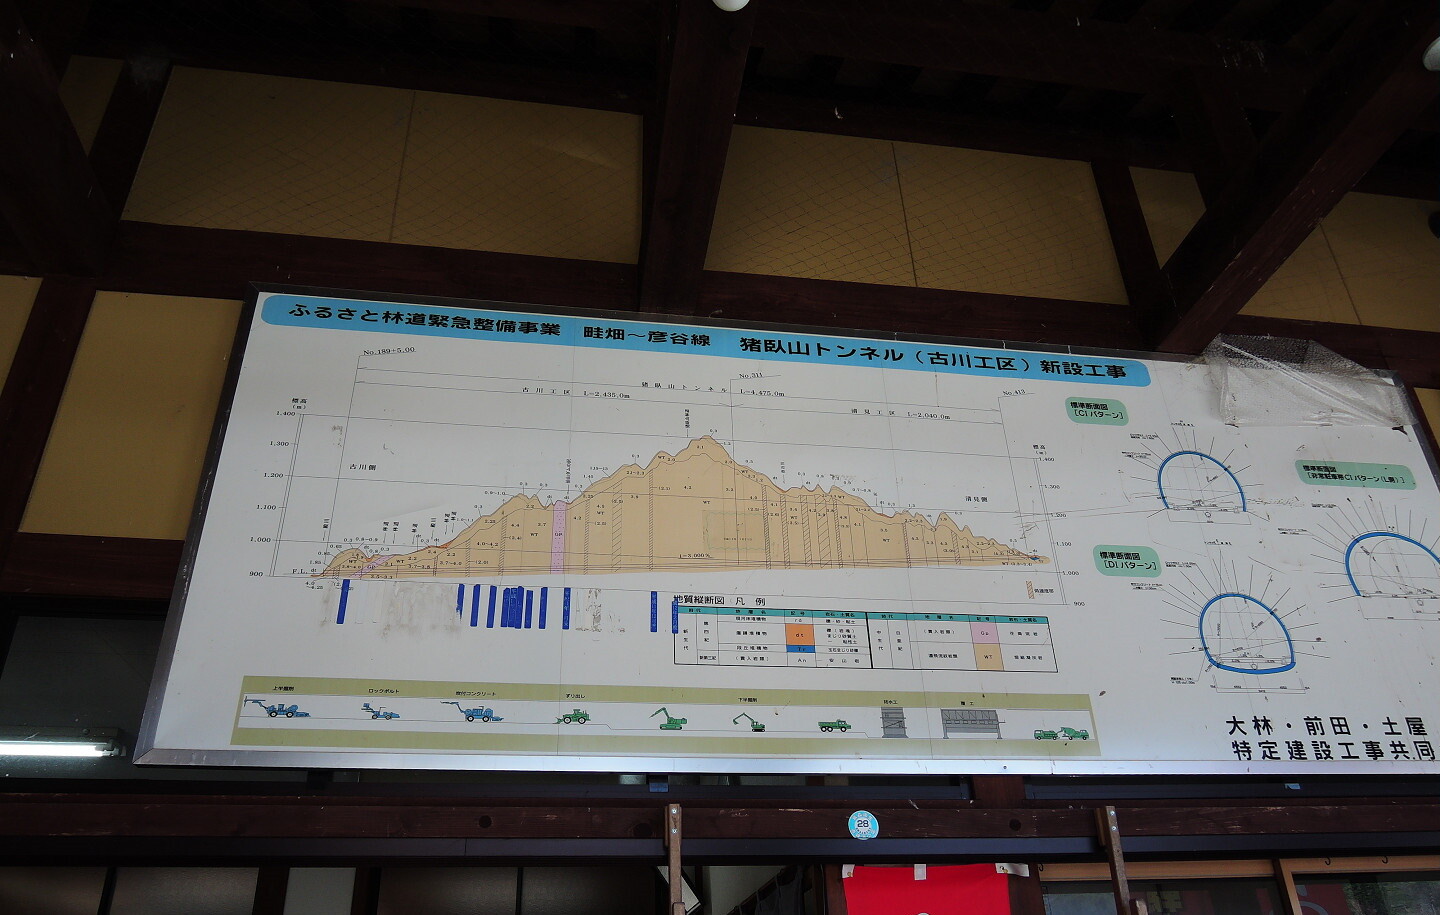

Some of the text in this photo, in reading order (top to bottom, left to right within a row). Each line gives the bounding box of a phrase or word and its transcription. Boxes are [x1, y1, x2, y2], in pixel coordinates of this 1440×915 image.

[289, 303, 561, 336] ふるさと林道緊急整備事業
[1225, 715, 1428, 736] 大林・前田・土屋
[1231, 740, 1436, 761] 特定建設工事共同
